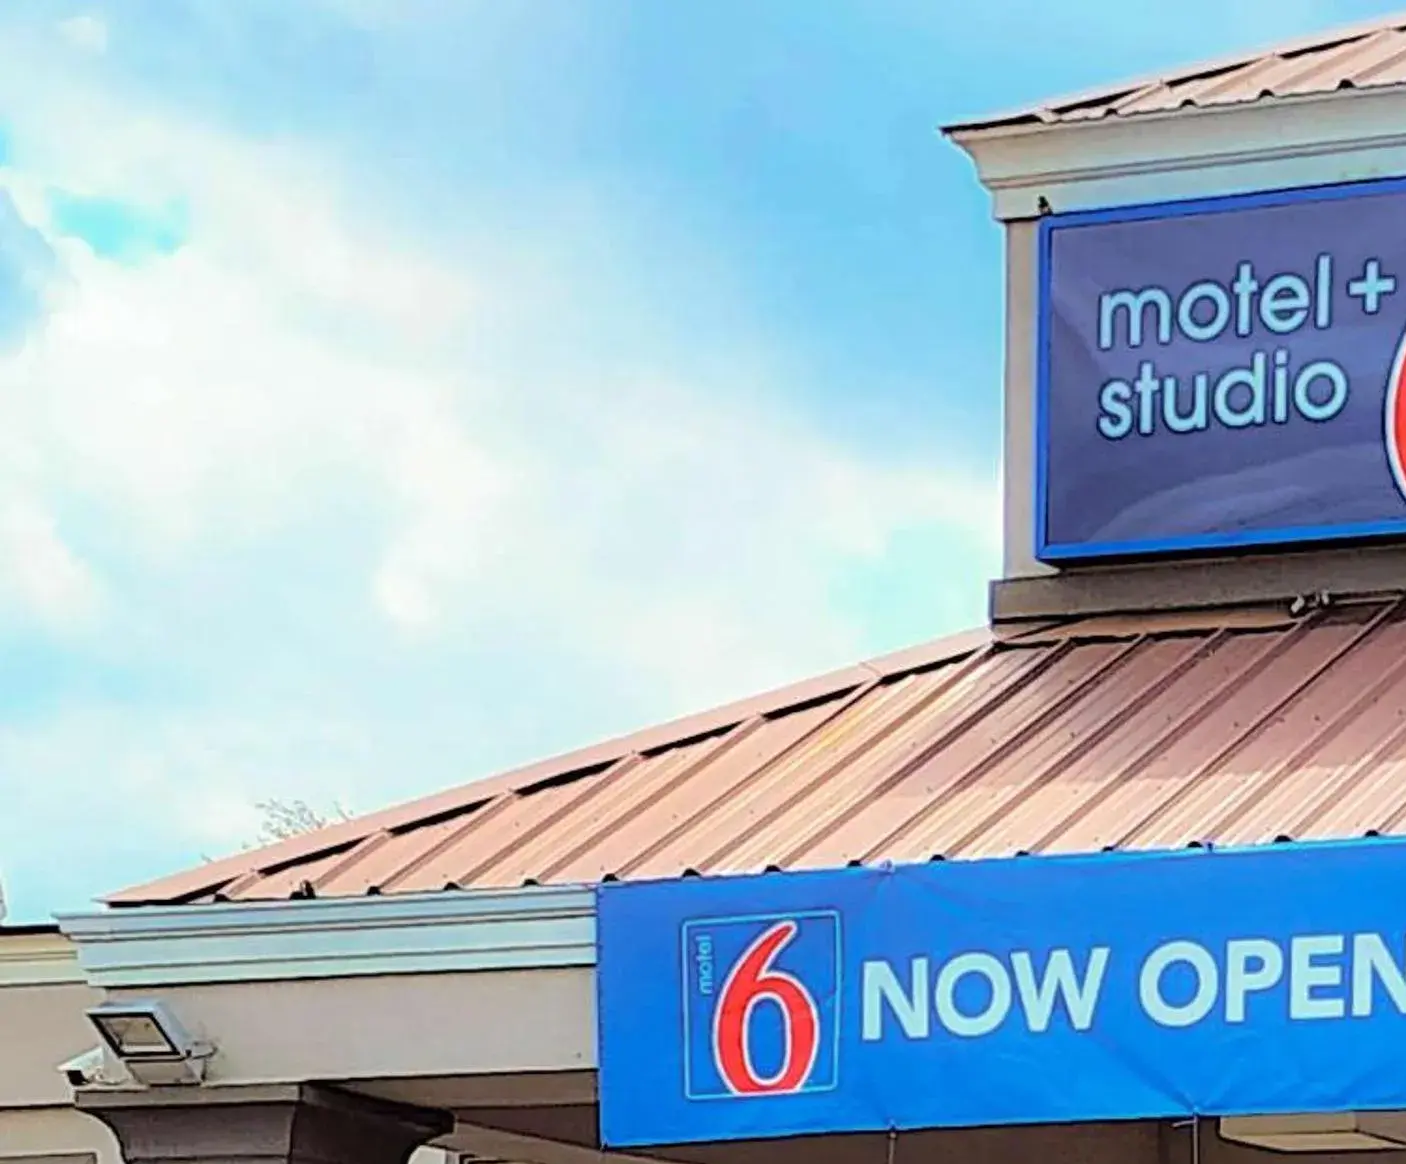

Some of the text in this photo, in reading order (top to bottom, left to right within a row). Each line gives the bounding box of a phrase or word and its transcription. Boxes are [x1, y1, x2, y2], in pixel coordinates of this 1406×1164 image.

[1100, 255, 1331, 350] motel
[1099, 350, 1349, 440] studio
[696, 933, 713, 995] motel
[712, 920, 820, 1097] 6
[861, 947, 1110, 1042] NOW
